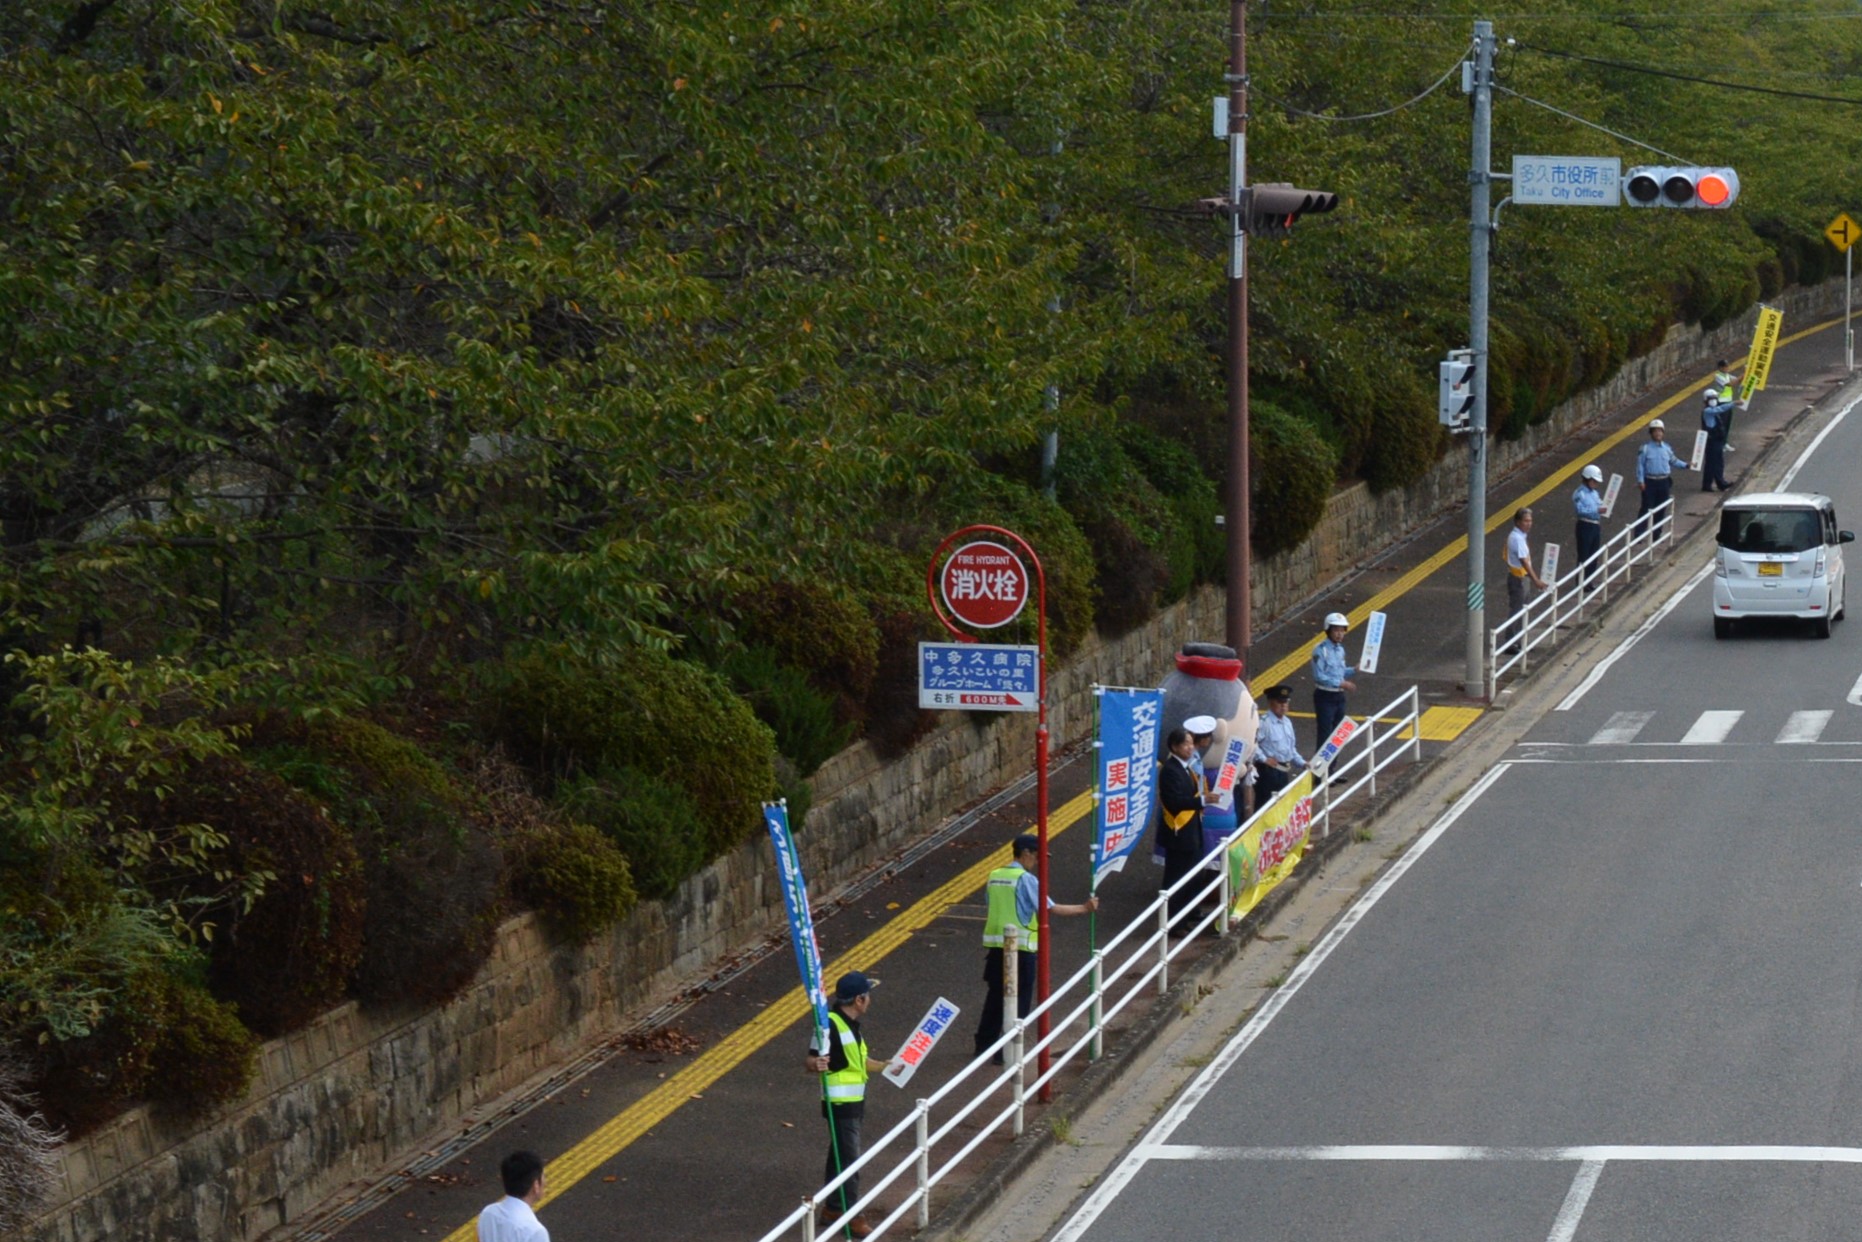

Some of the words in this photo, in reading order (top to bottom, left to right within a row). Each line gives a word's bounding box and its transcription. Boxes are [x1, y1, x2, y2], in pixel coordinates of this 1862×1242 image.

[1520, 164, 1614, 186] 多久市役所前
[1520, 186, 1543, 197] Taku
[1551, 186, 1570, 199] City
[1574, 187, 1605, 199] Office
[958, 555, 974, 565] FIRE
[976, 556, 1010, 565] HYDRANT
[951, 569, 1019, 601] 消火栓
[924, 649, 1033, 667] 中多久病院
[931, 665, 1026, 678] 多久いこいの里
[929, 676, 992, 689] グループホーム
[934, 693, 955, 704] 右折
[1217, 739, 1244, 791] 追突注意
[899, 1002, 955, 1067] 速度注意
